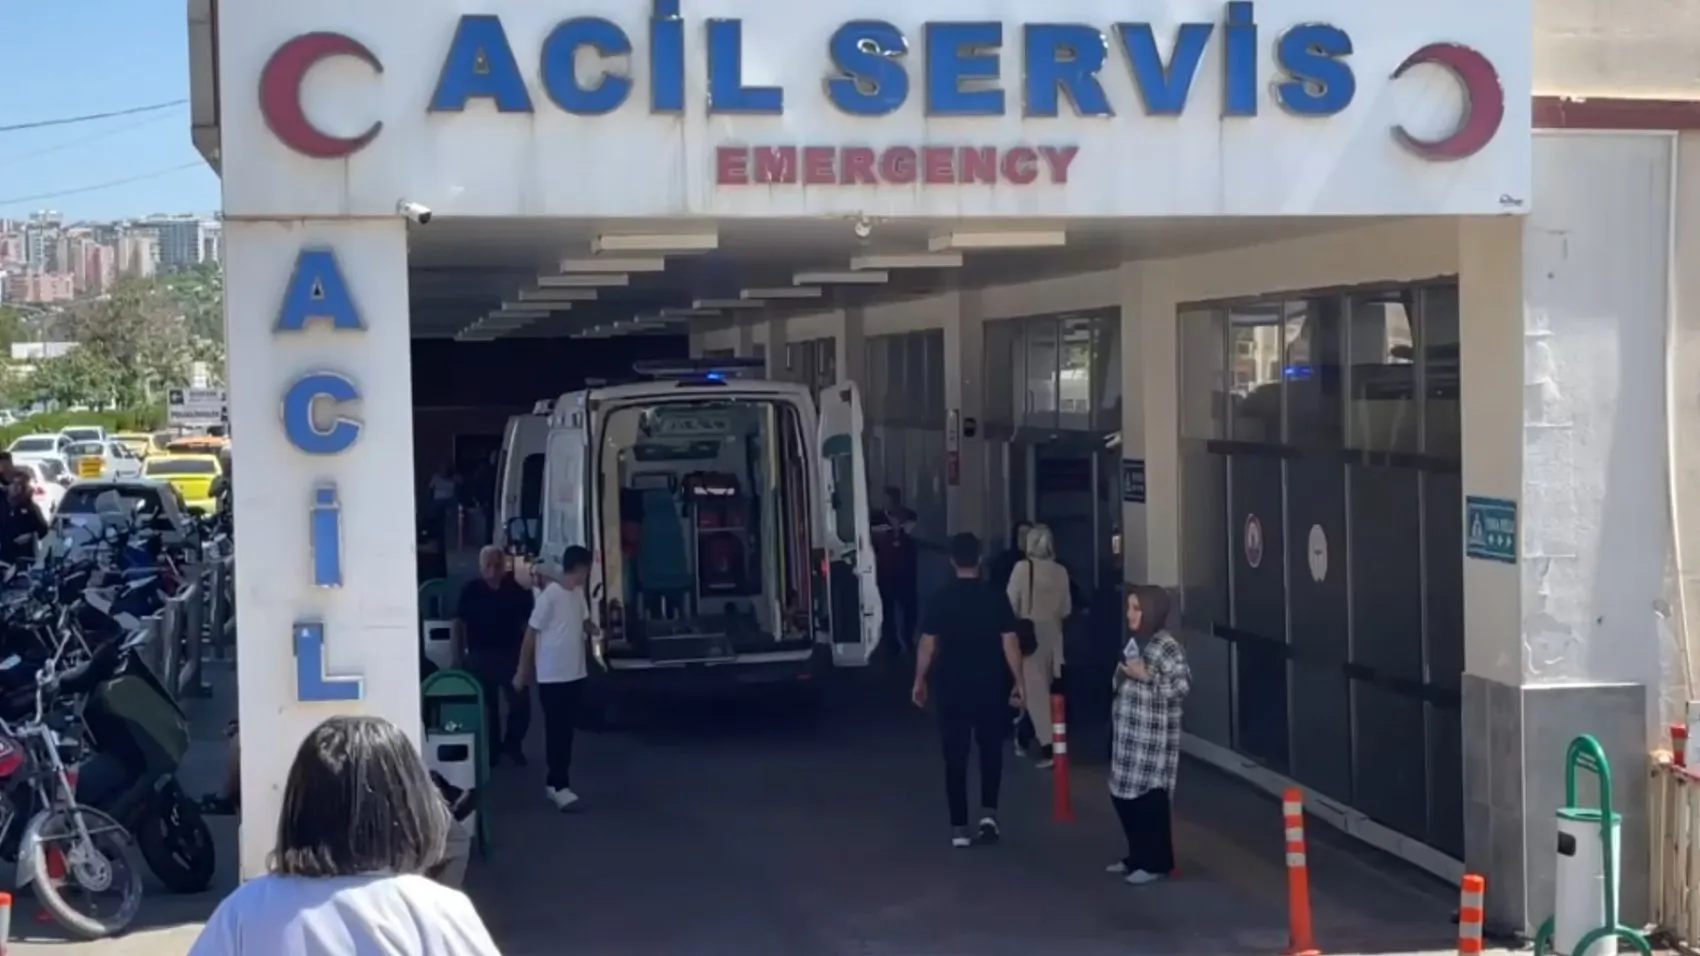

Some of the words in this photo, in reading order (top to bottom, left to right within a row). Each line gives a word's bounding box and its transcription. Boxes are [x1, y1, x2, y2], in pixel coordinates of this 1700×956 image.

[427, 0, 784, 116] ACİL
[824, 1, 1357, 118] SERVİS
[715, 145, 1080, 186] EMERGENCY
[273, 247, 368, 702] ACİL
